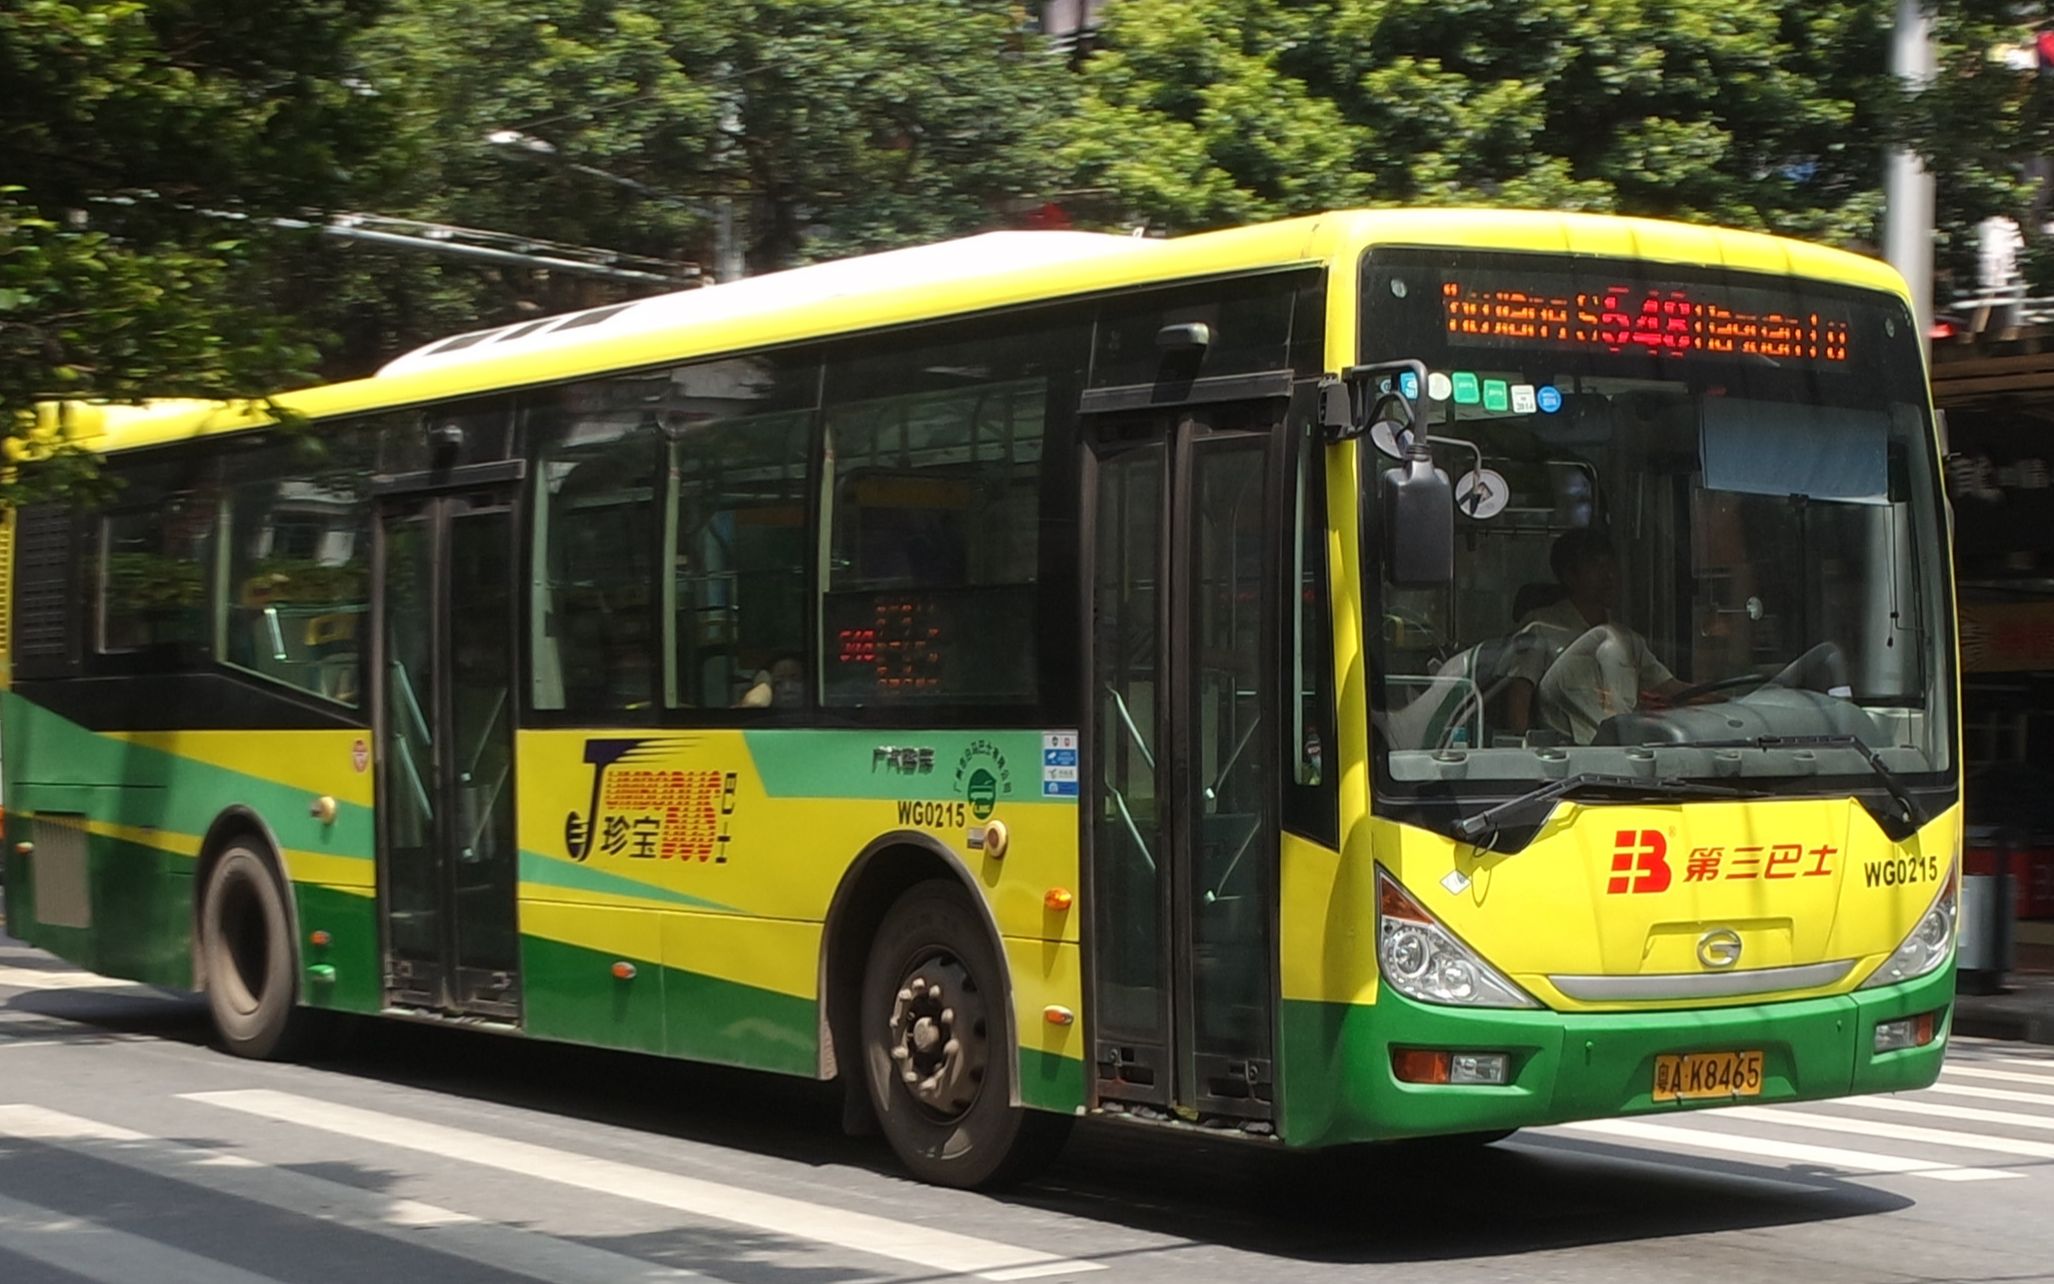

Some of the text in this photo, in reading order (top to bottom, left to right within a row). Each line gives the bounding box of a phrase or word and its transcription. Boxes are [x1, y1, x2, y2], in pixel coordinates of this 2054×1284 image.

[1600, 286, 1691, 356] 548
[897, 800, 966, 829] WG0215
[601, 816, 661, 859] 珍宝
[1683, 844, 1838, 883] 第三巴士
[1864, 856, 1938, 888] WG0215
